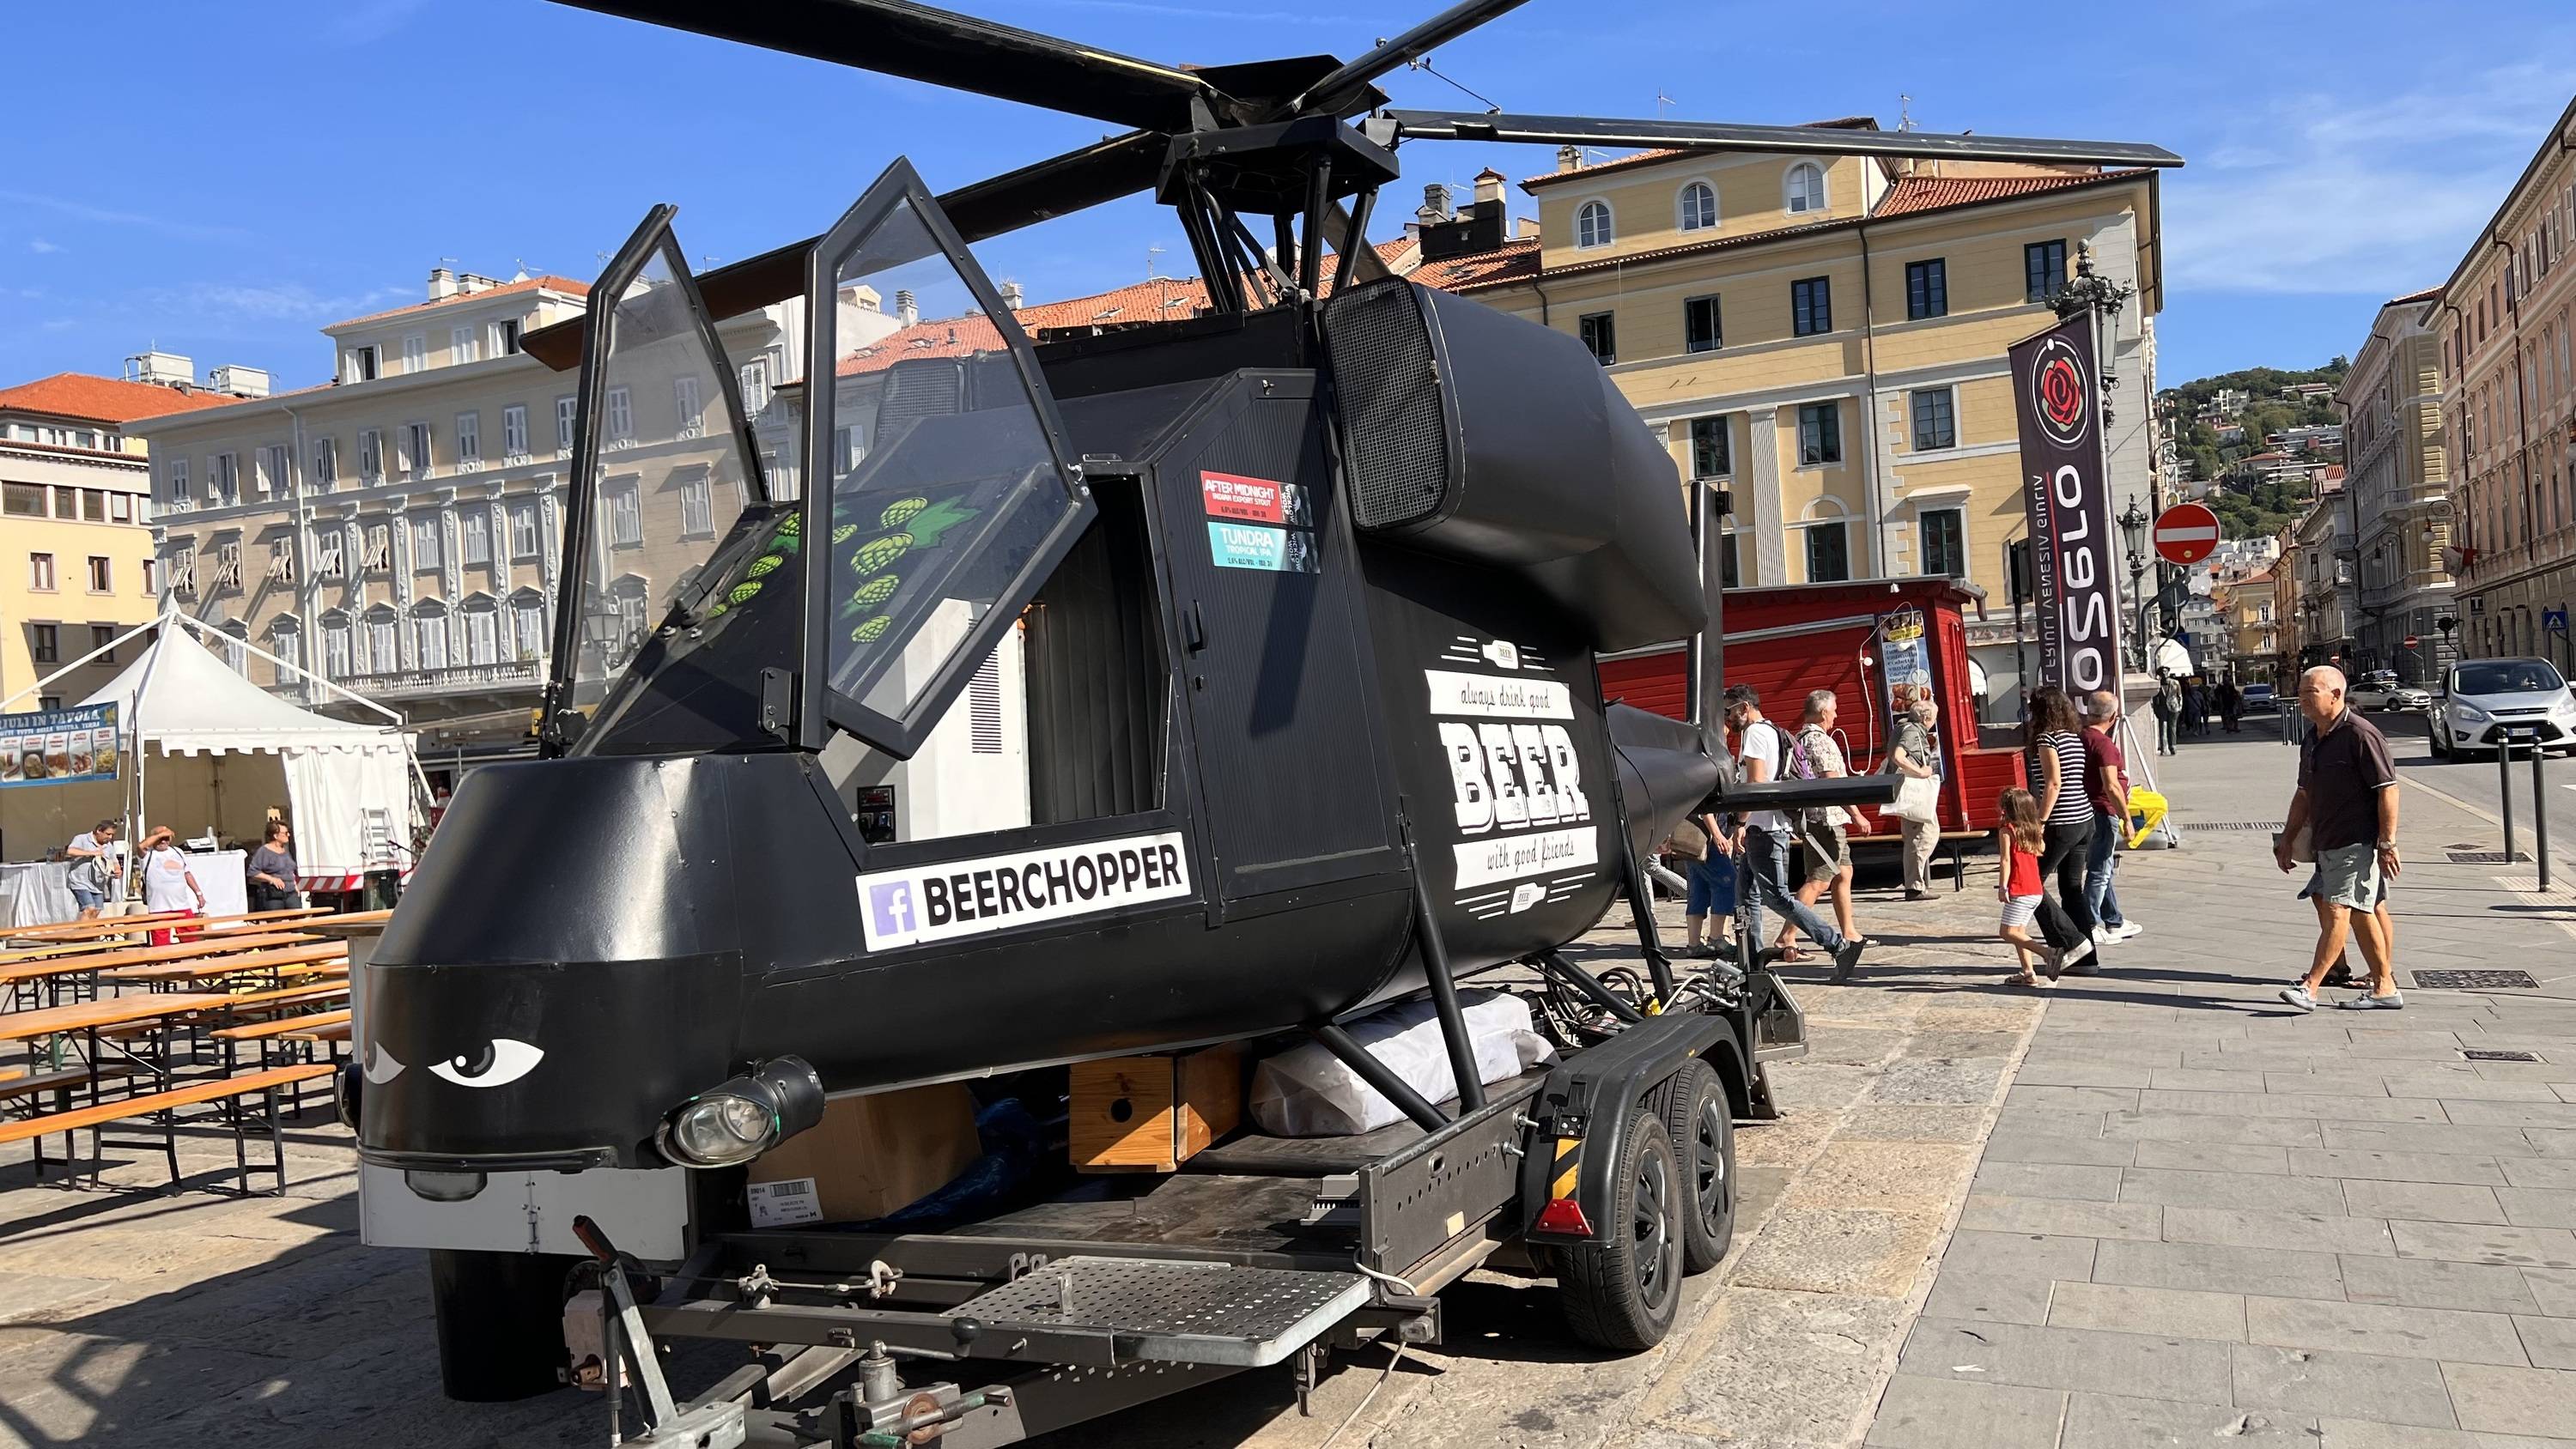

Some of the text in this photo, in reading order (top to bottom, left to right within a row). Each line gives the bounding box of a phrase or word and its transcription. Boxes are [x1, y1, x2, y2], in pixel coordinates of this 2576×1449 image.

[1205, 479, 1275, 500] AFTER MIDNIGHT
[1233, 495, 1254, 505] EXPORT
[1255, 499, 1272, 507] STOUT
[1280, 492, 1290, 515] WOLF
[1285, 485, 1294, 523] WICKLOW
[1220, 527, 1274, 548] TUNDRA
[1225, 544, 1273, 557] TROPICAL IPA
[1291, 532, 1301, 571] WICKLOW
[1498, 647, 1512, 658] BEER
[1461, 681, 1551, 713] always drink good
[0, 709, 100, 729] IULI IN TAVOLA
[1438, 722, 1590, 835] BEER
[1487, 833, 1575, 872] with good friends
[922, 843, 1182, 927] BEERCHOPPER
